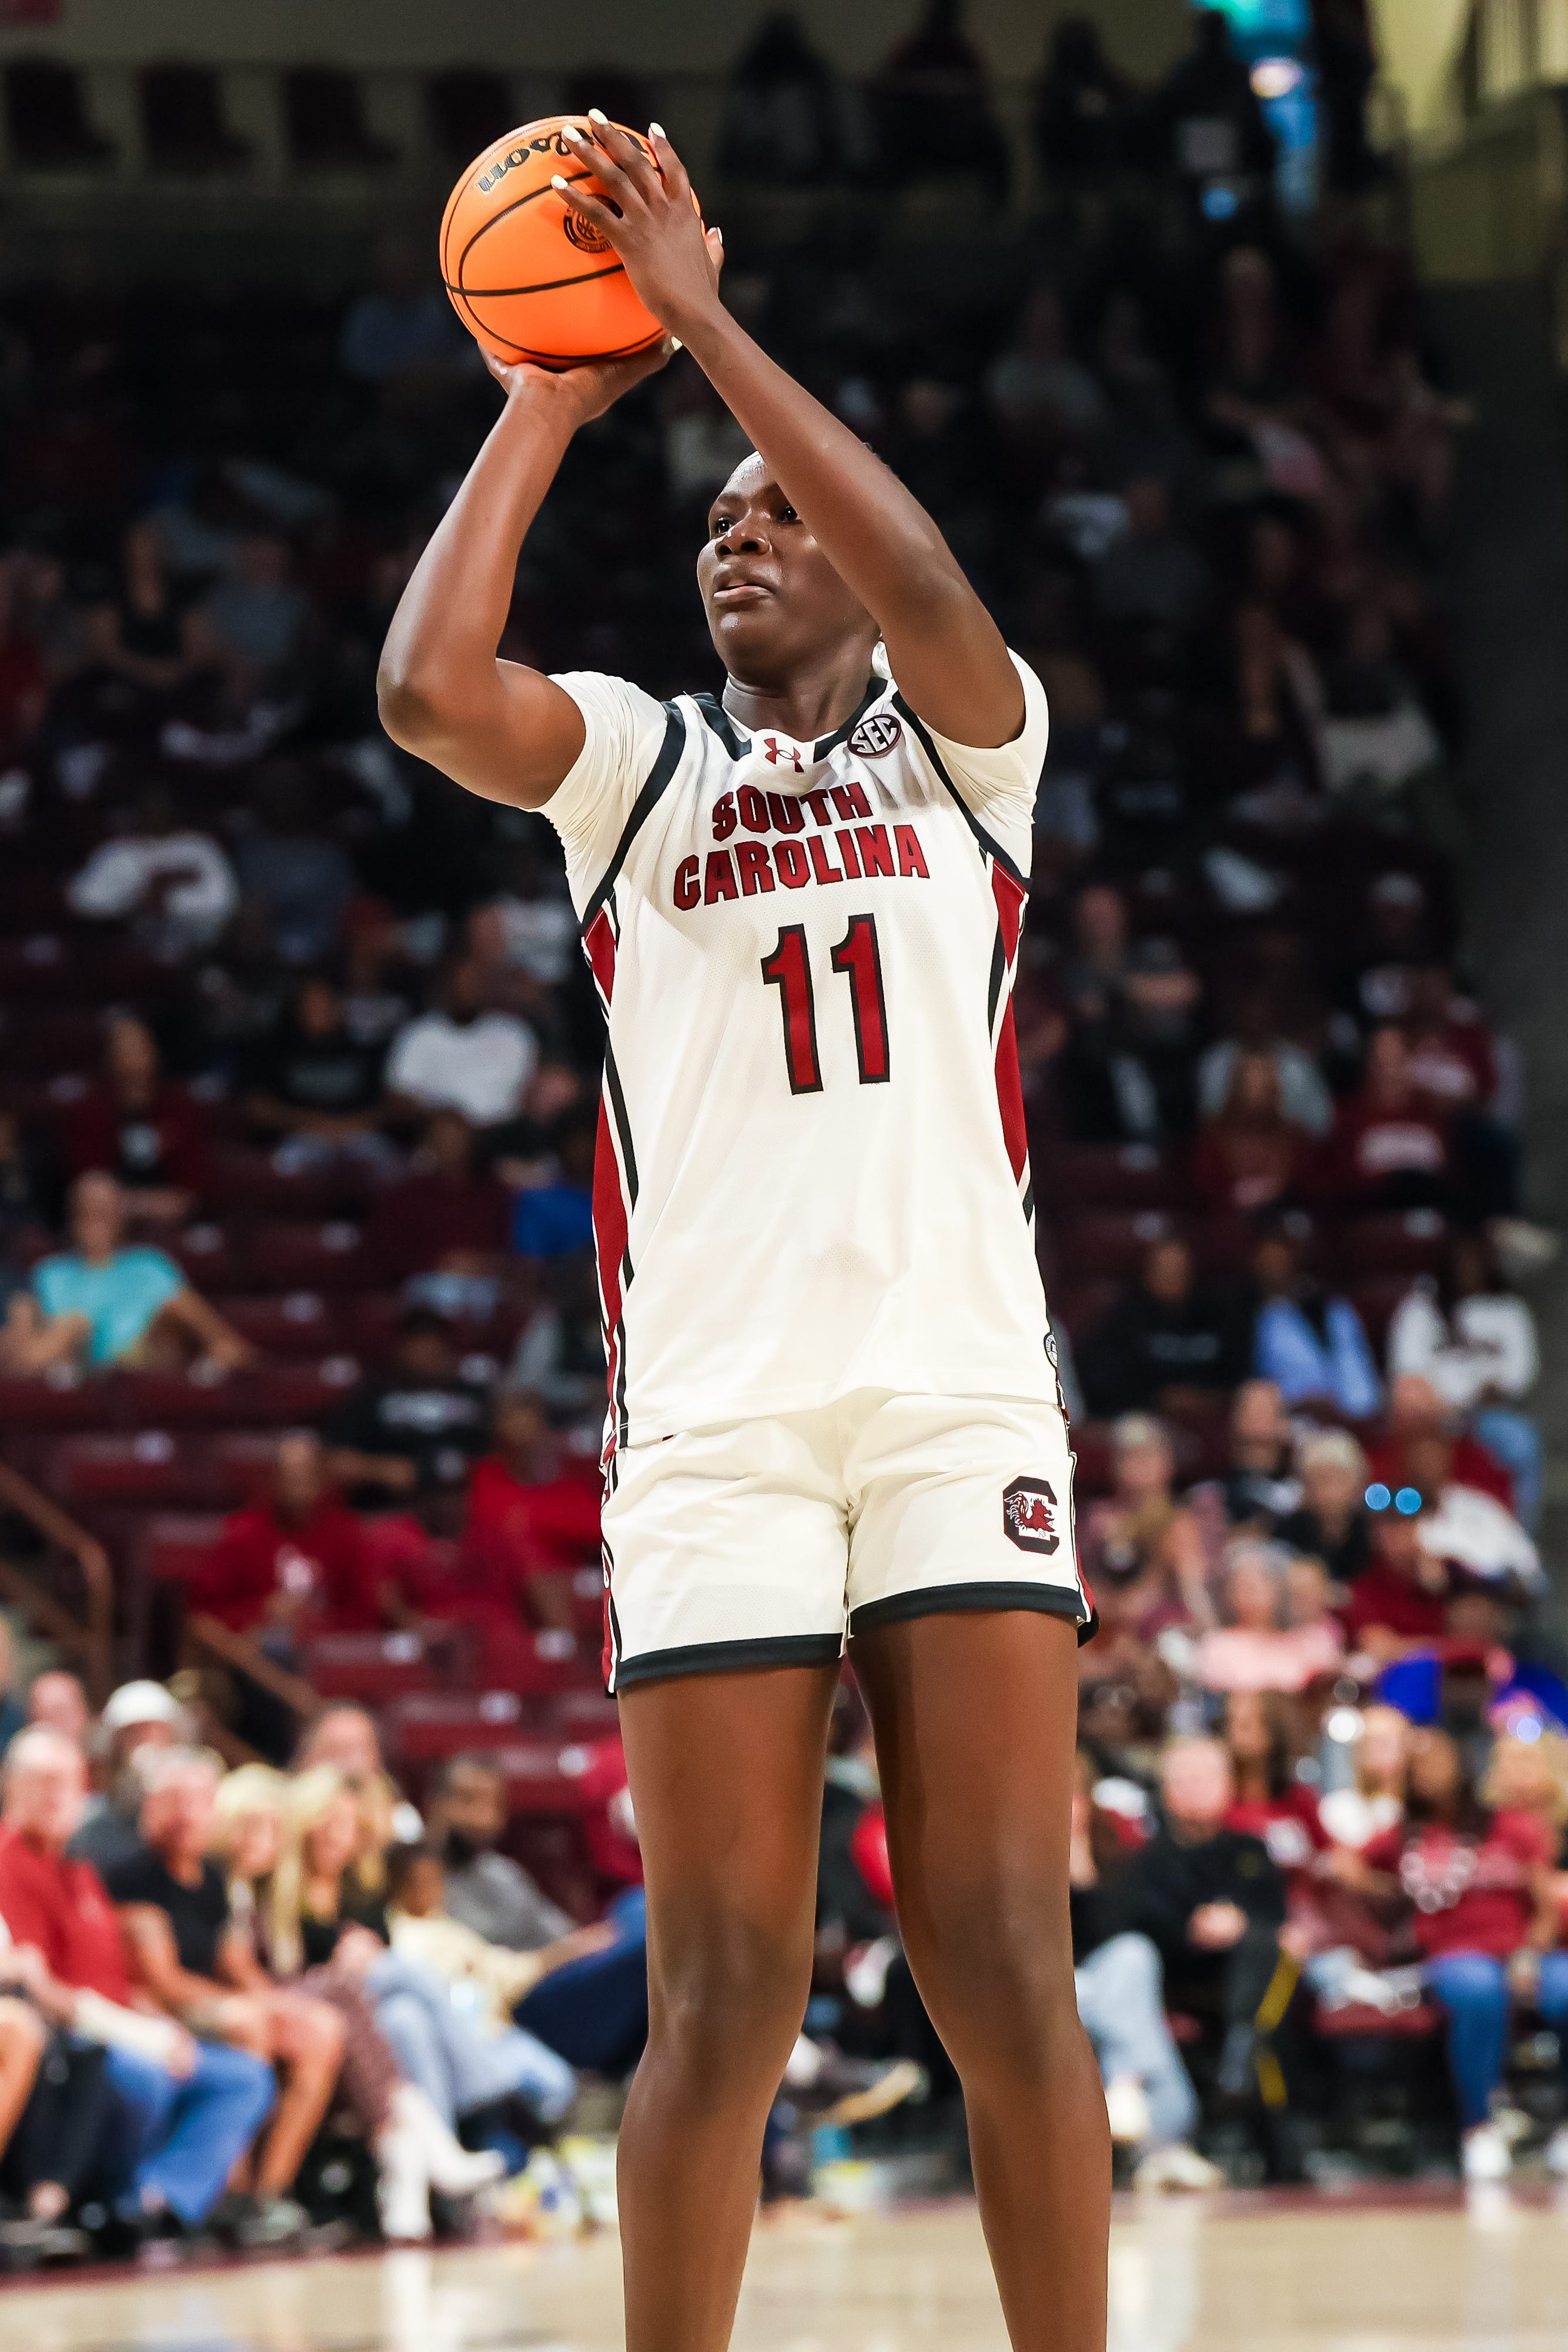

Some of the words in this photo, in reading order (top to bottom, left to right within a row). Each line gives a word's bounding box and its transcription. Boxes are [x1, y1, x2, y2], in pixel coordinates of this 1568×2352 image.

[851, 717, 897, 753] SEC
[711, 782, 872, 843] SOUTH
[673, 825, 930, 911] CAROLINA
[760, 913, 890, 1095] 11
